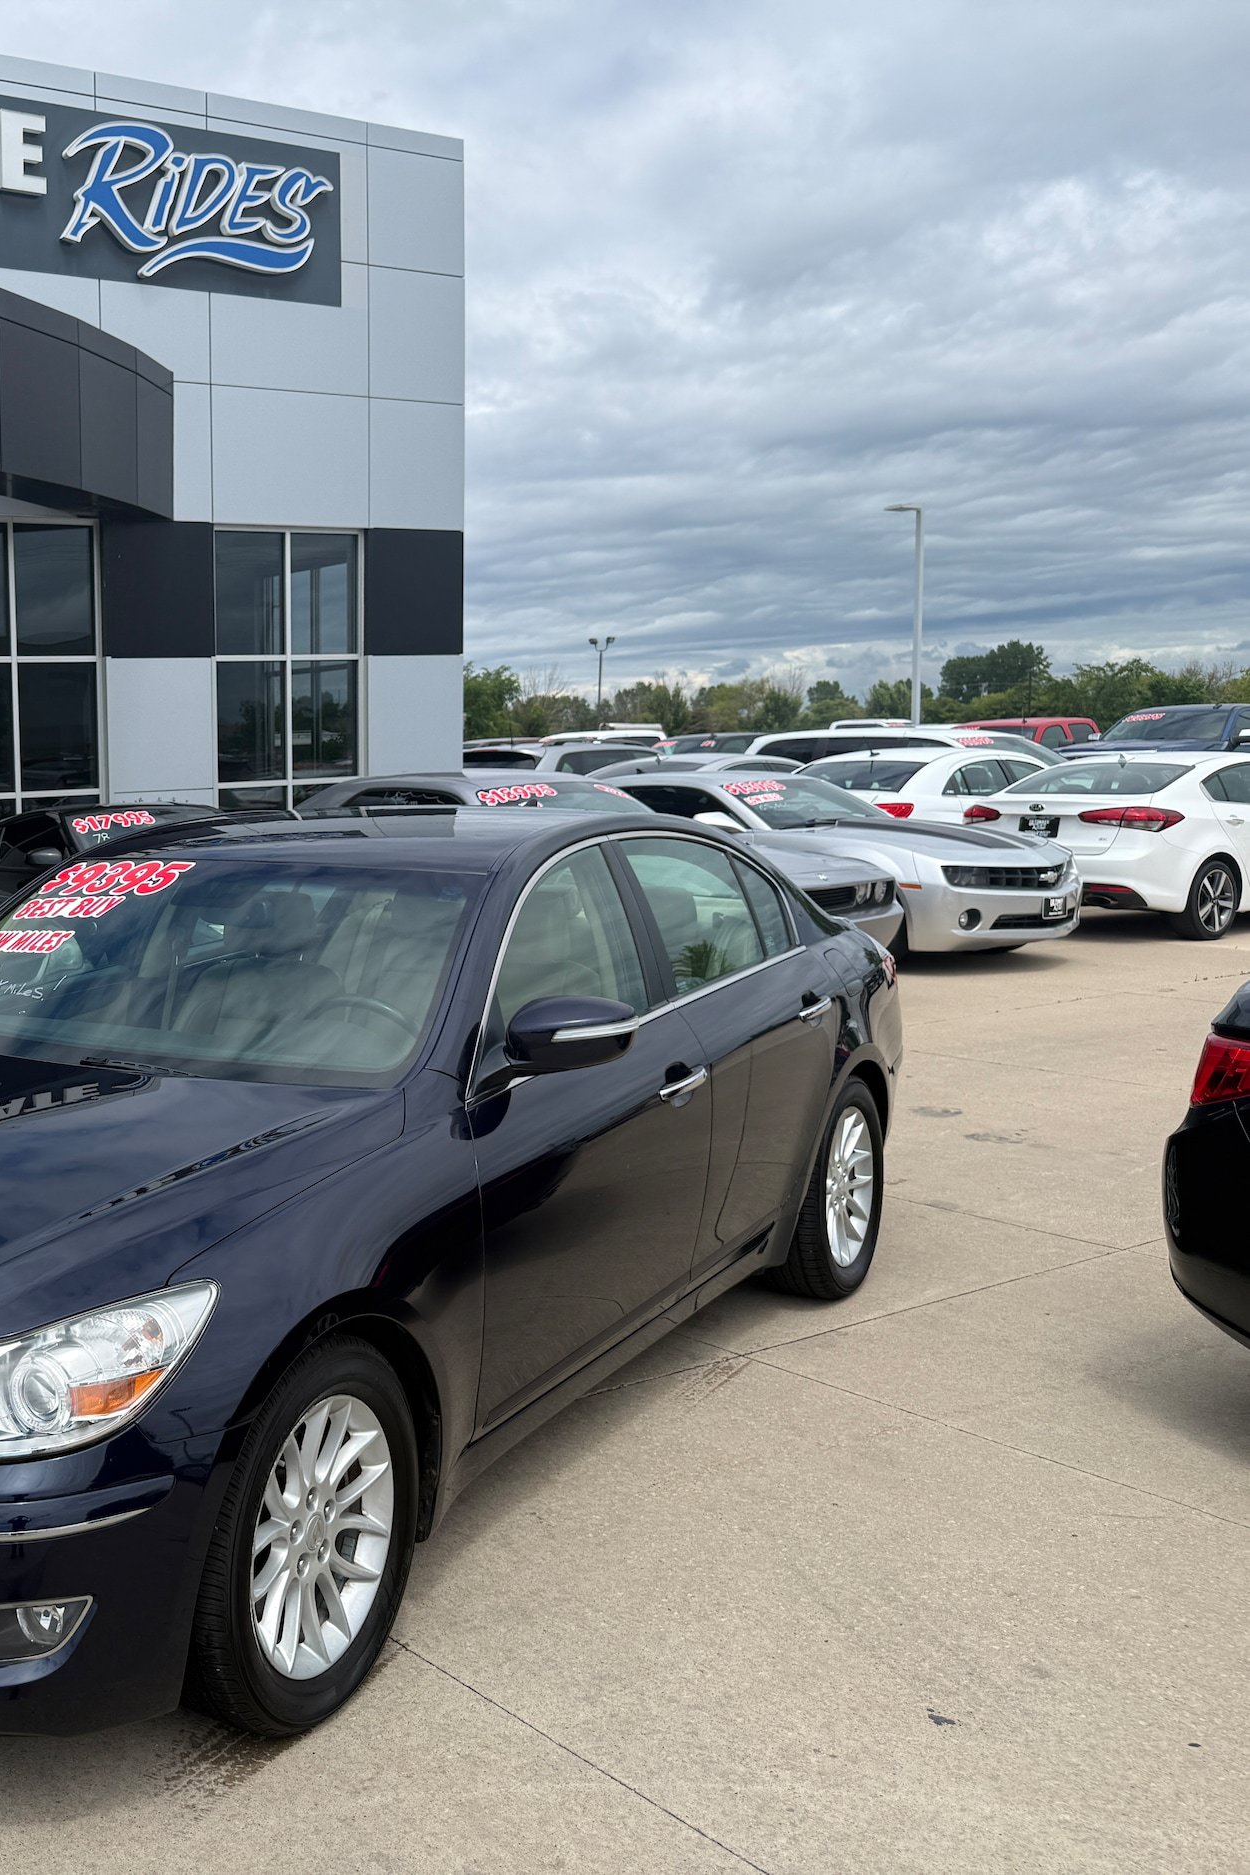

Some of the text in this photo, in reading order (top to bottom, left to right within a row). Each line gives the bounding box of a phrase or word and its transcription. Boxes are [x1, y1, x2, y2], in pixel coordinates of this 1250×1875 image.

[72, 811, 155, 834] $17995
[38, 861, 197, 896] $9395
[13, 896, 126, 920] BEST BUY
[8, 930, 75, 954] MILES
